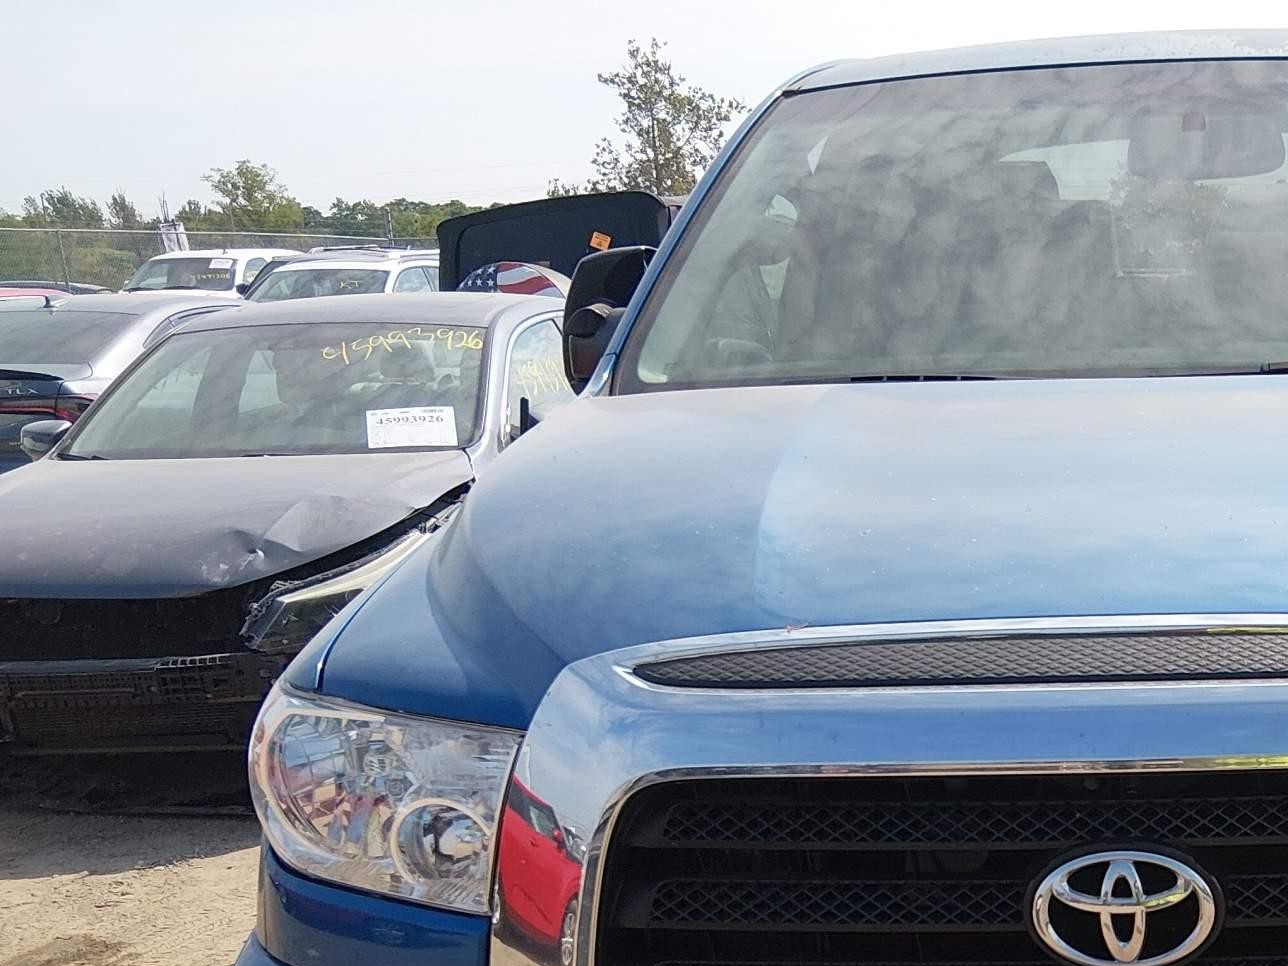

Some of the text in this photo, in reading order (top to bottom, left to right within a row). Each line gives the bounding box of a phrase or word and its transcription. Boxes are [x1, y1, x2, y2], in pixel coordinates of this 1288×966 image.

[320, 327, 484, 365] 45993926
[7, 387, 39, 395] TLX
[375, 414, 445, 426] 45993926
